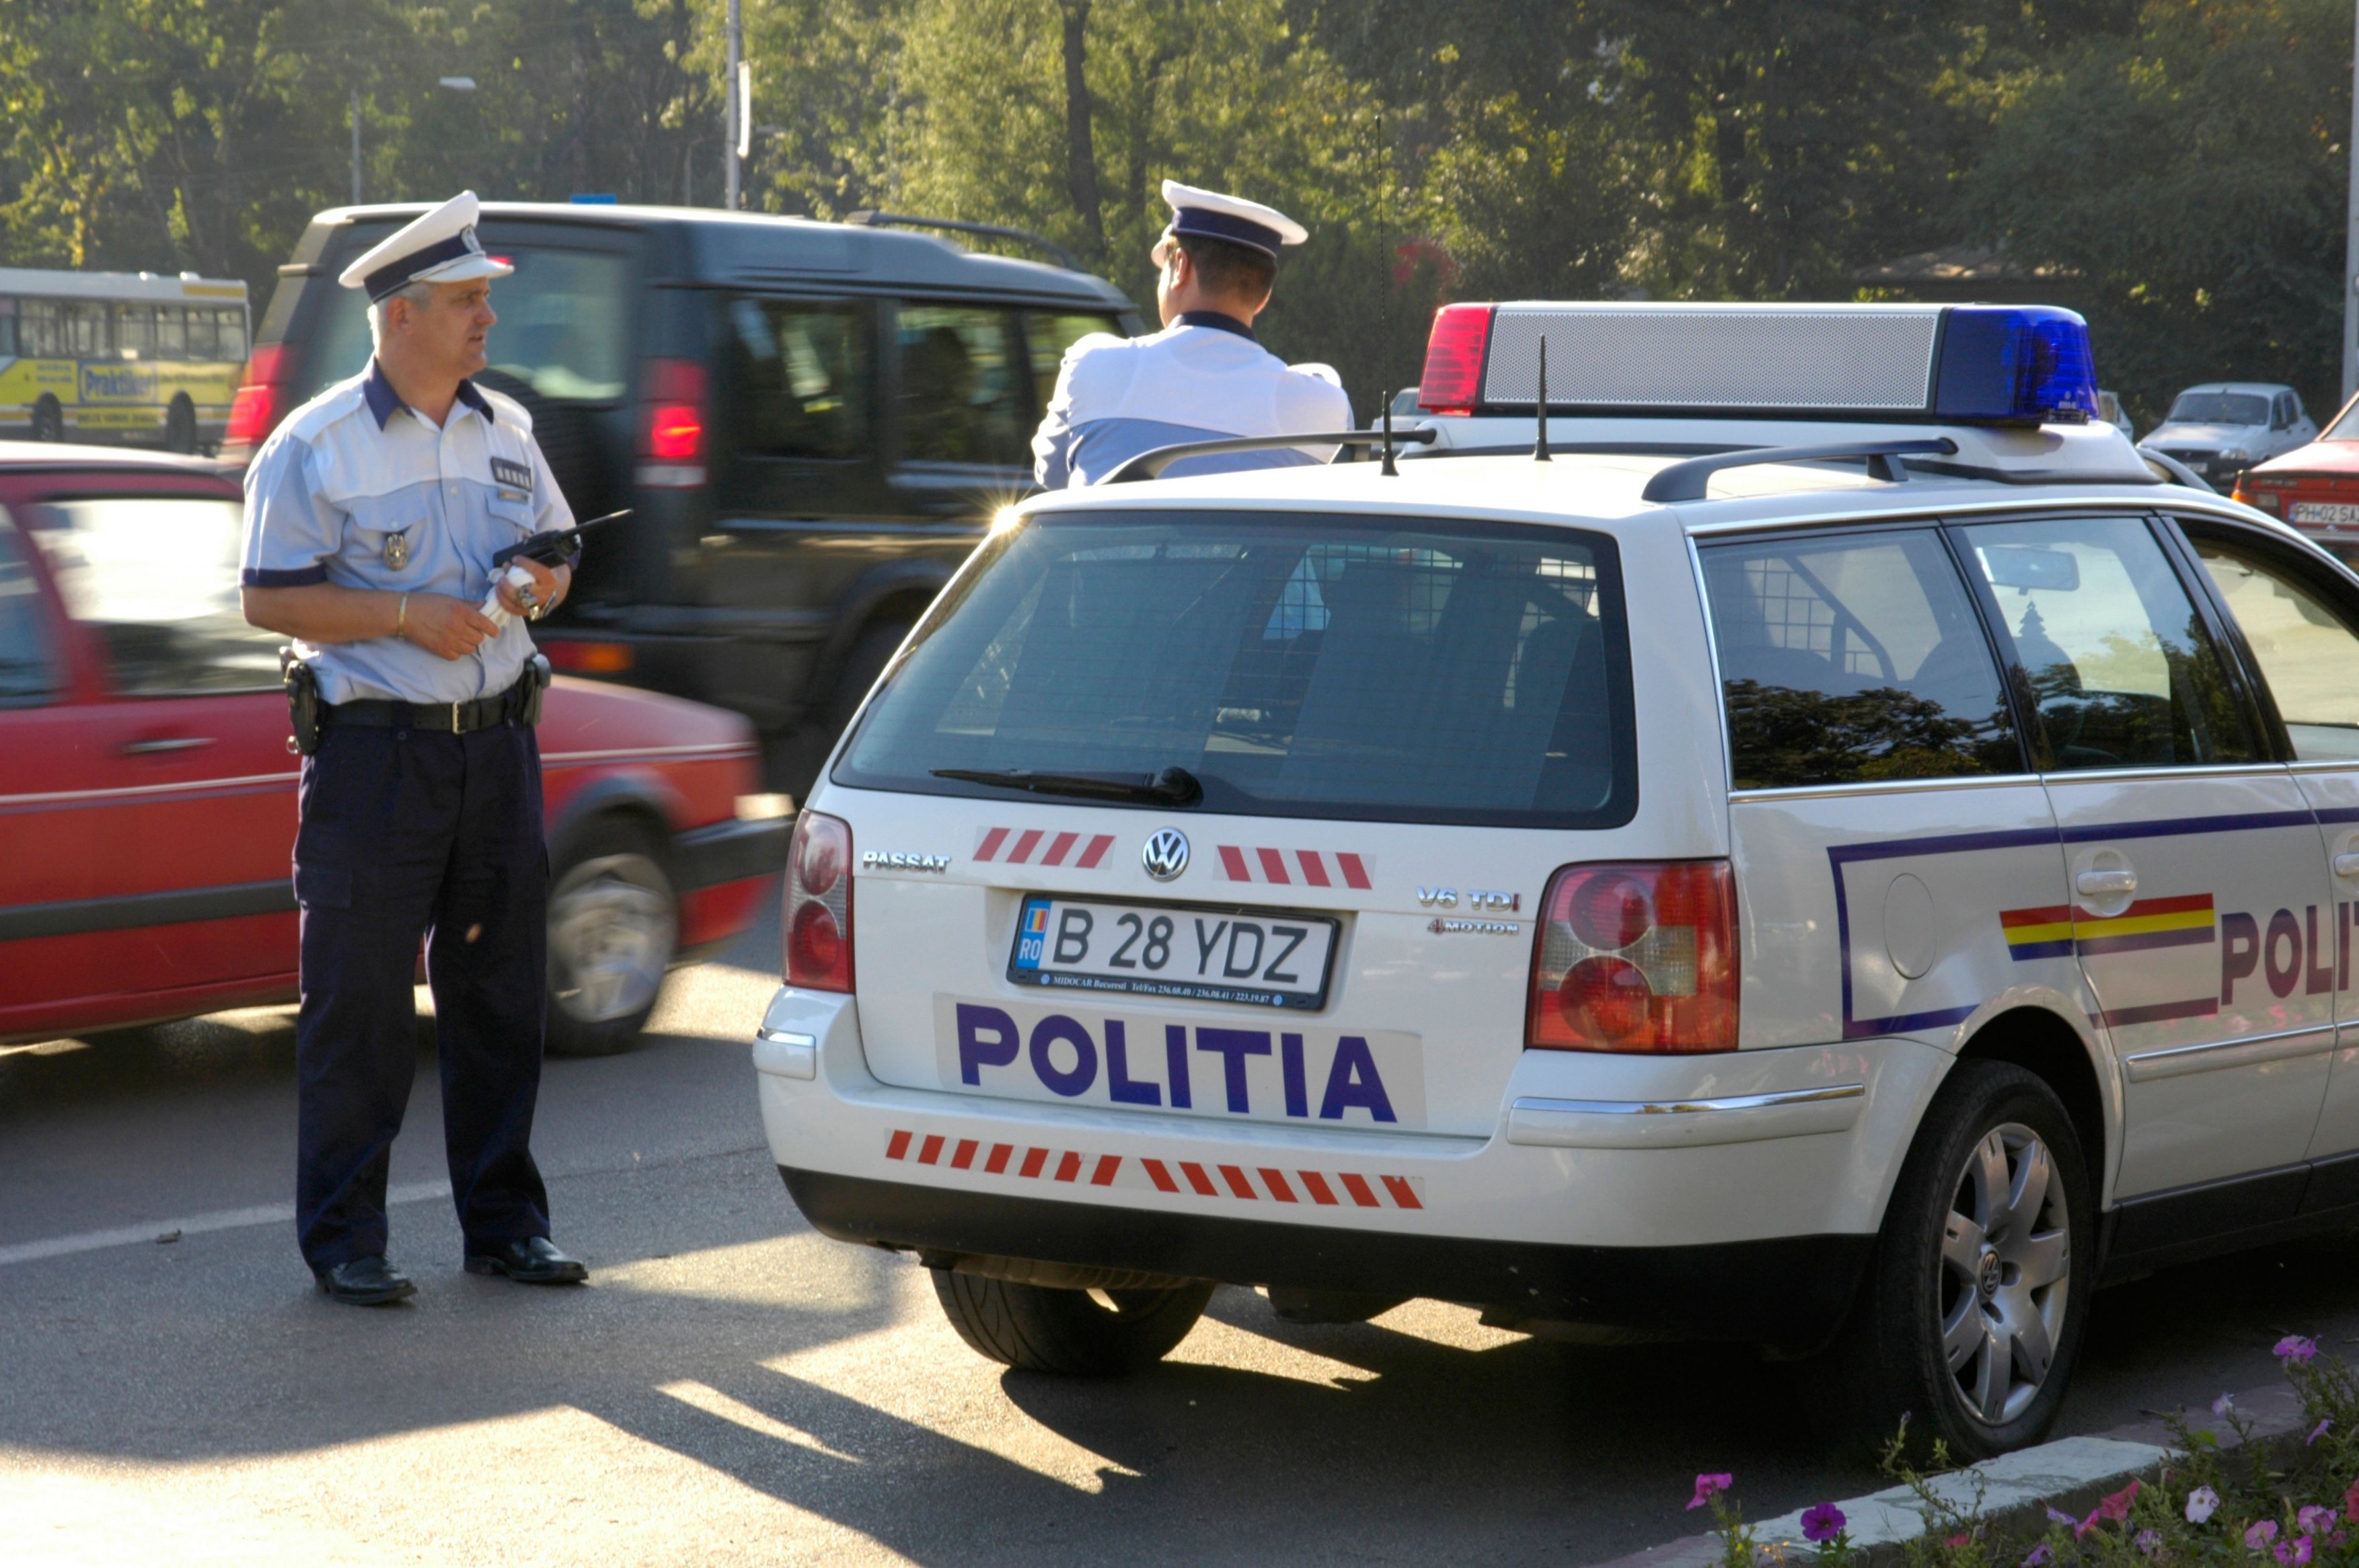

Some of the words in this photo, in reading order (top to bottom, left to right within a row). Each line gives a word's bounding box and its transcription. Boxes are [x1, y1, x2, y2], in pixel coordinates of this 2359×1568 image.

[2296, 505, 2315, 521] PH
[2321, 505, 2335, 521] 02
[2339, 506, 2359, 523] SA
[864, 851, 951, 874] PASSAT
[1416, 886, 1458, 909] V6
[1467, 889, 1521, 912] TDI
[1427, 916, 1519, 935] 4MOTION
[1019, 938, 1042, 961] RO
[1053, 908, 1094, 964] B
[1109, 913, 1174, 970] 28
[1194, 919, 1308, 983] YDZ
[2221, 899, 2359, 1006] POLI
[1053, 975, 1092, 987] MIDOCAR
[1094, 979, 1127, 990] Bucuresti
[955, 1003, 1398, 1123] POLITIA
